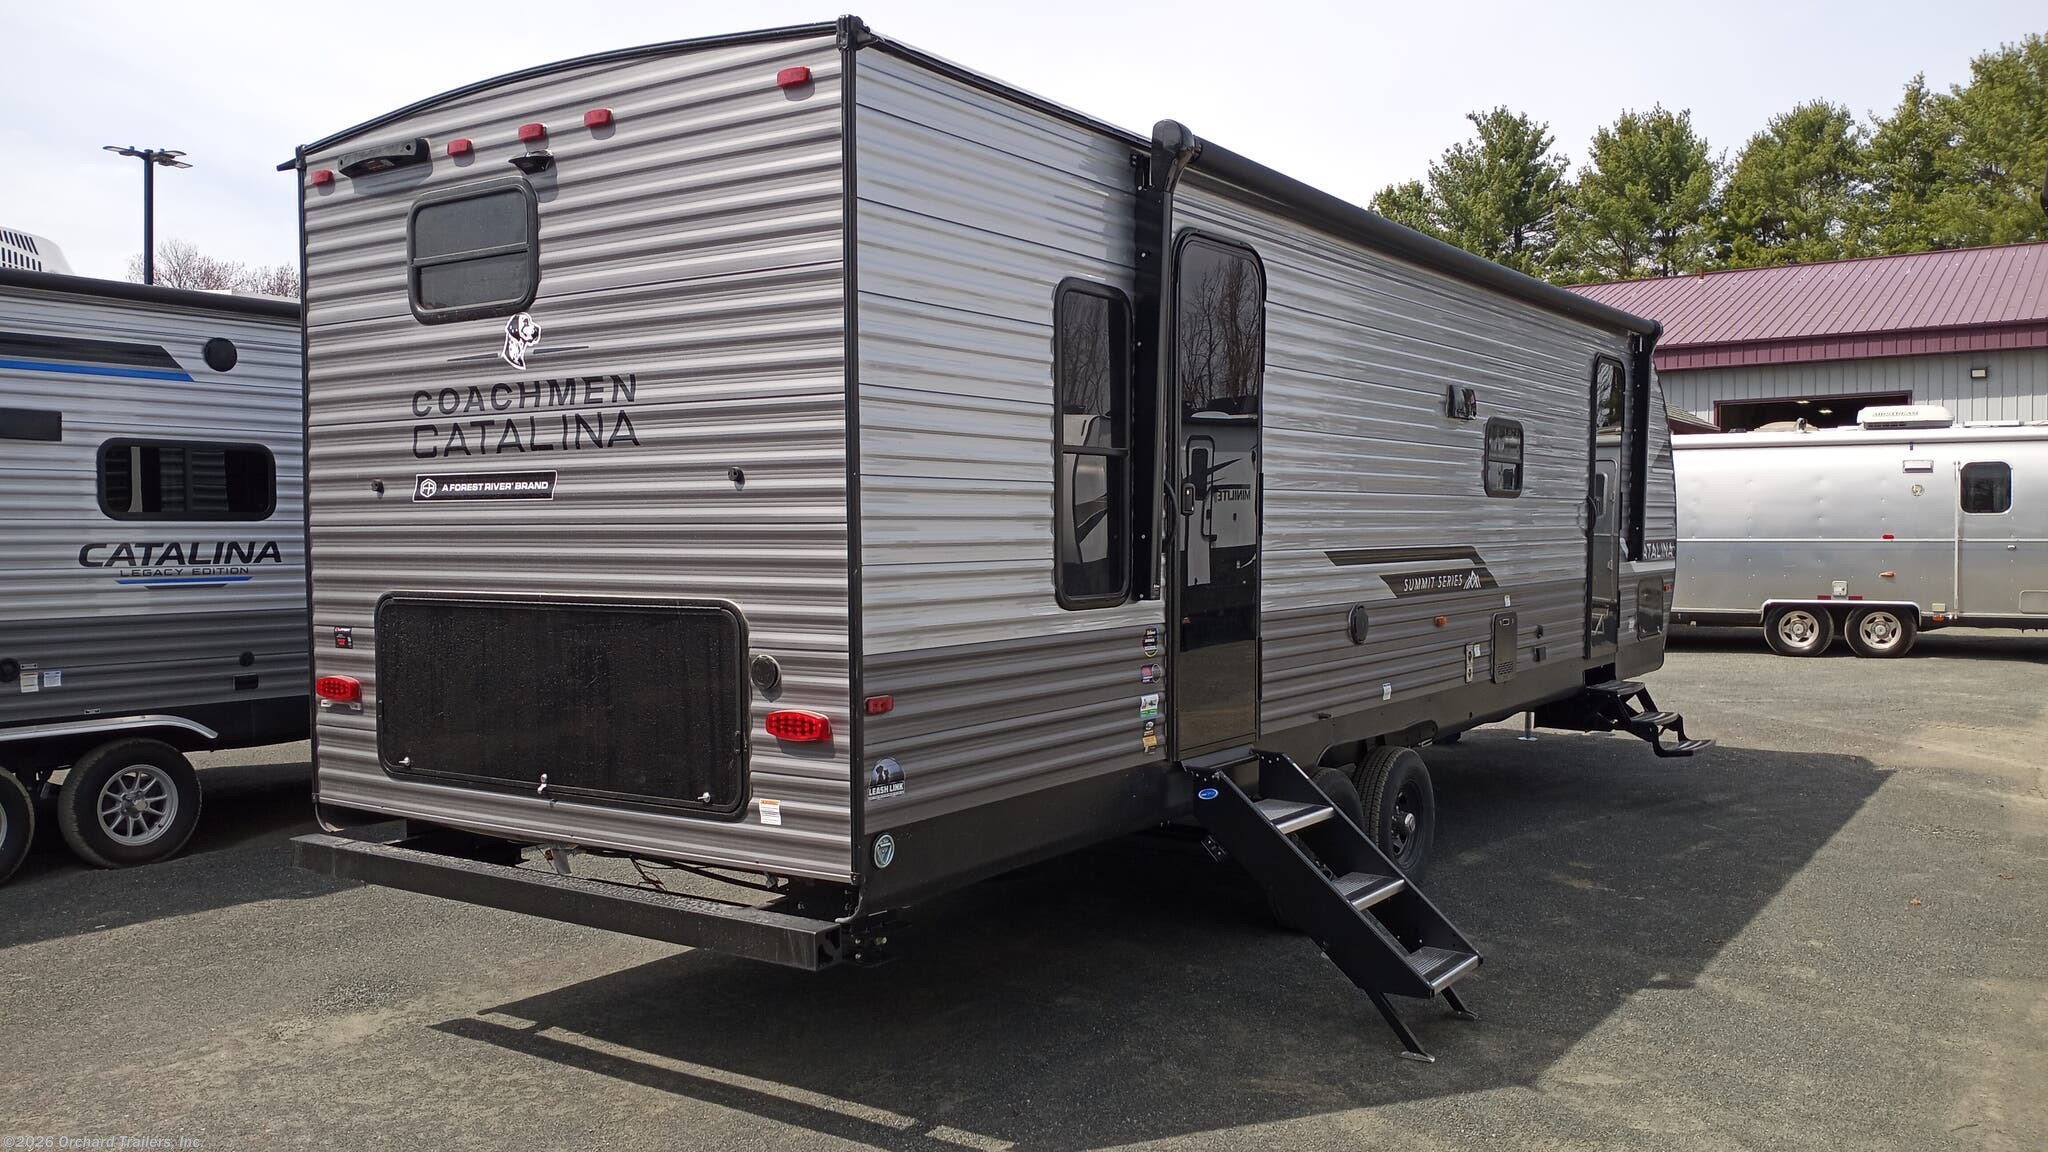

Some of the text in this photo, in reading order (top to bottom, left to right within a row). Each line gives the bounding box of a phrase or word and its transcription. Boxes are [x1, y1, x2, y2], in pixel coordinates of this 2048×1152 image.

[412, 374, 636, 417] COACHMEN
[412, 410, 641, 459] CATALINA
[442, 484, 449, 492] A
[449, 483, 484, 491] FOREST
[514, 481, 549, 490] BRAND
[78, 541, 282, 567] CATALINA
[1643, 542, 1675, 560] ATALINA
[120, 567, 249, 577] LEGACY EDITION
[1403, 574, 1463, 592] SUMMIT SERIES
[869, 786, 889, 796] LEASH
[889, 783, 904, 793] LINK
